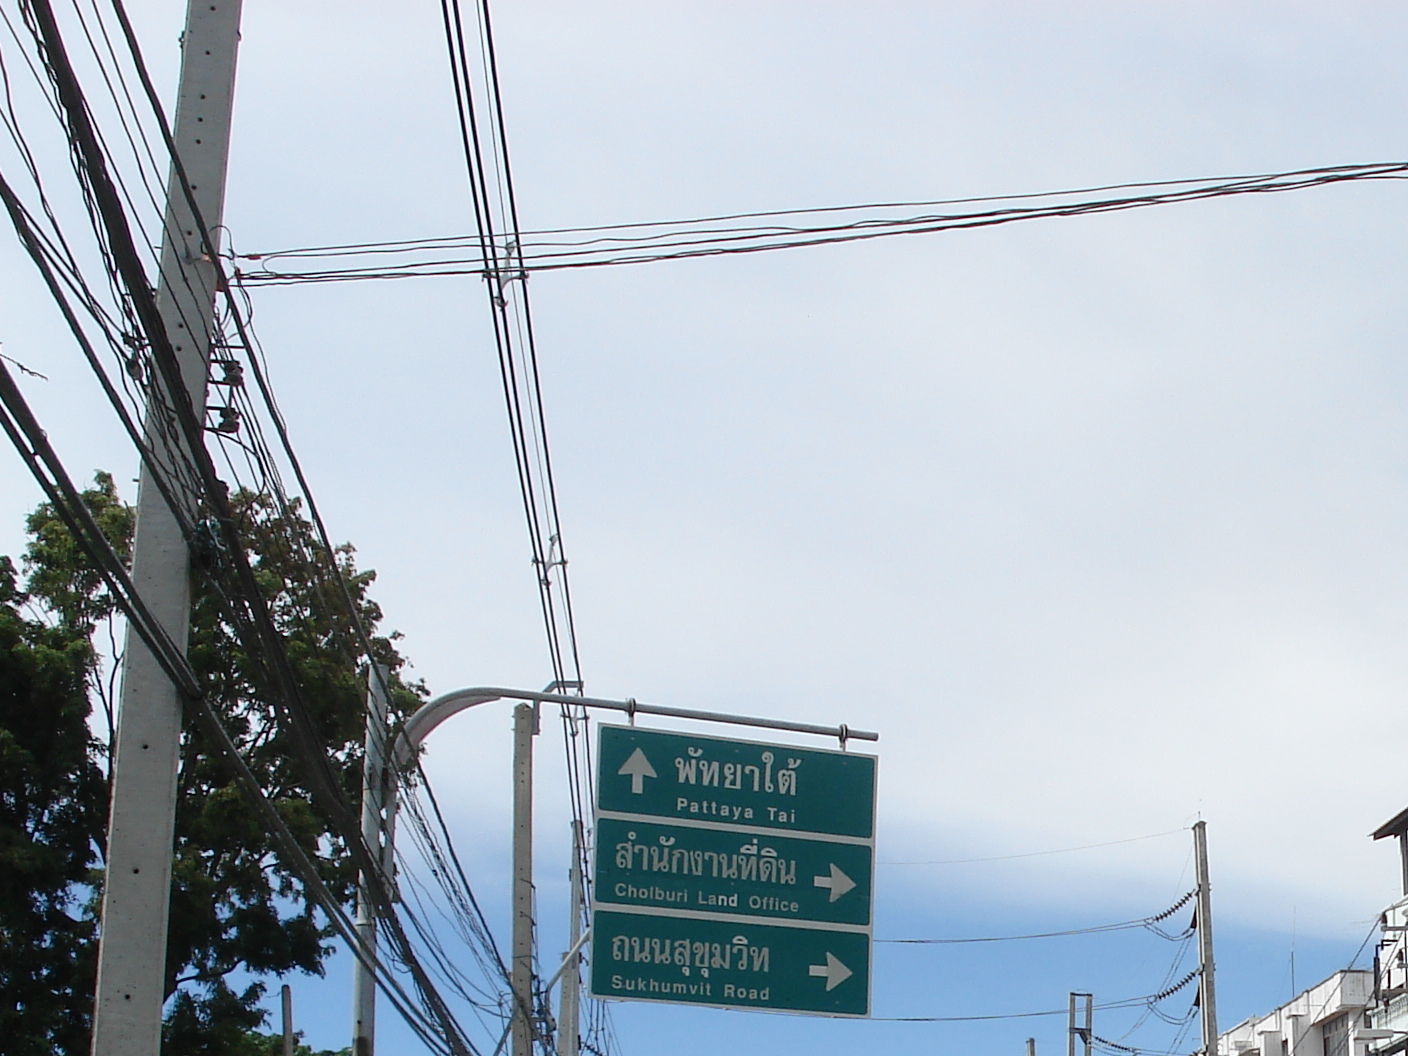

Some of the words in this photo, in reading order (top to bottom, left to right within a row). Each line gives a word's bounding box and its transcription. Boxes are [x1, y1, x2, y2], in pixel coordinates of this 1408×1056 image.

[675, 746, 801, 796] พัทยาใต้
[677, 797, 753, 820] Pattaya
[767, 806, 796, 823] Tai
[615, 831, 796, 886] สำนักงานที่ดิน
[614, 882, 688, 903] Cholburi
[698, 890, 738, 908] Land
[749, 895, 800, 913] Office
[611, 934, 770, 978] ถนนสุขุมวิท
[611, 974, 712, 997] Sukhumvit
[724, 984, 770, 1001] Road
